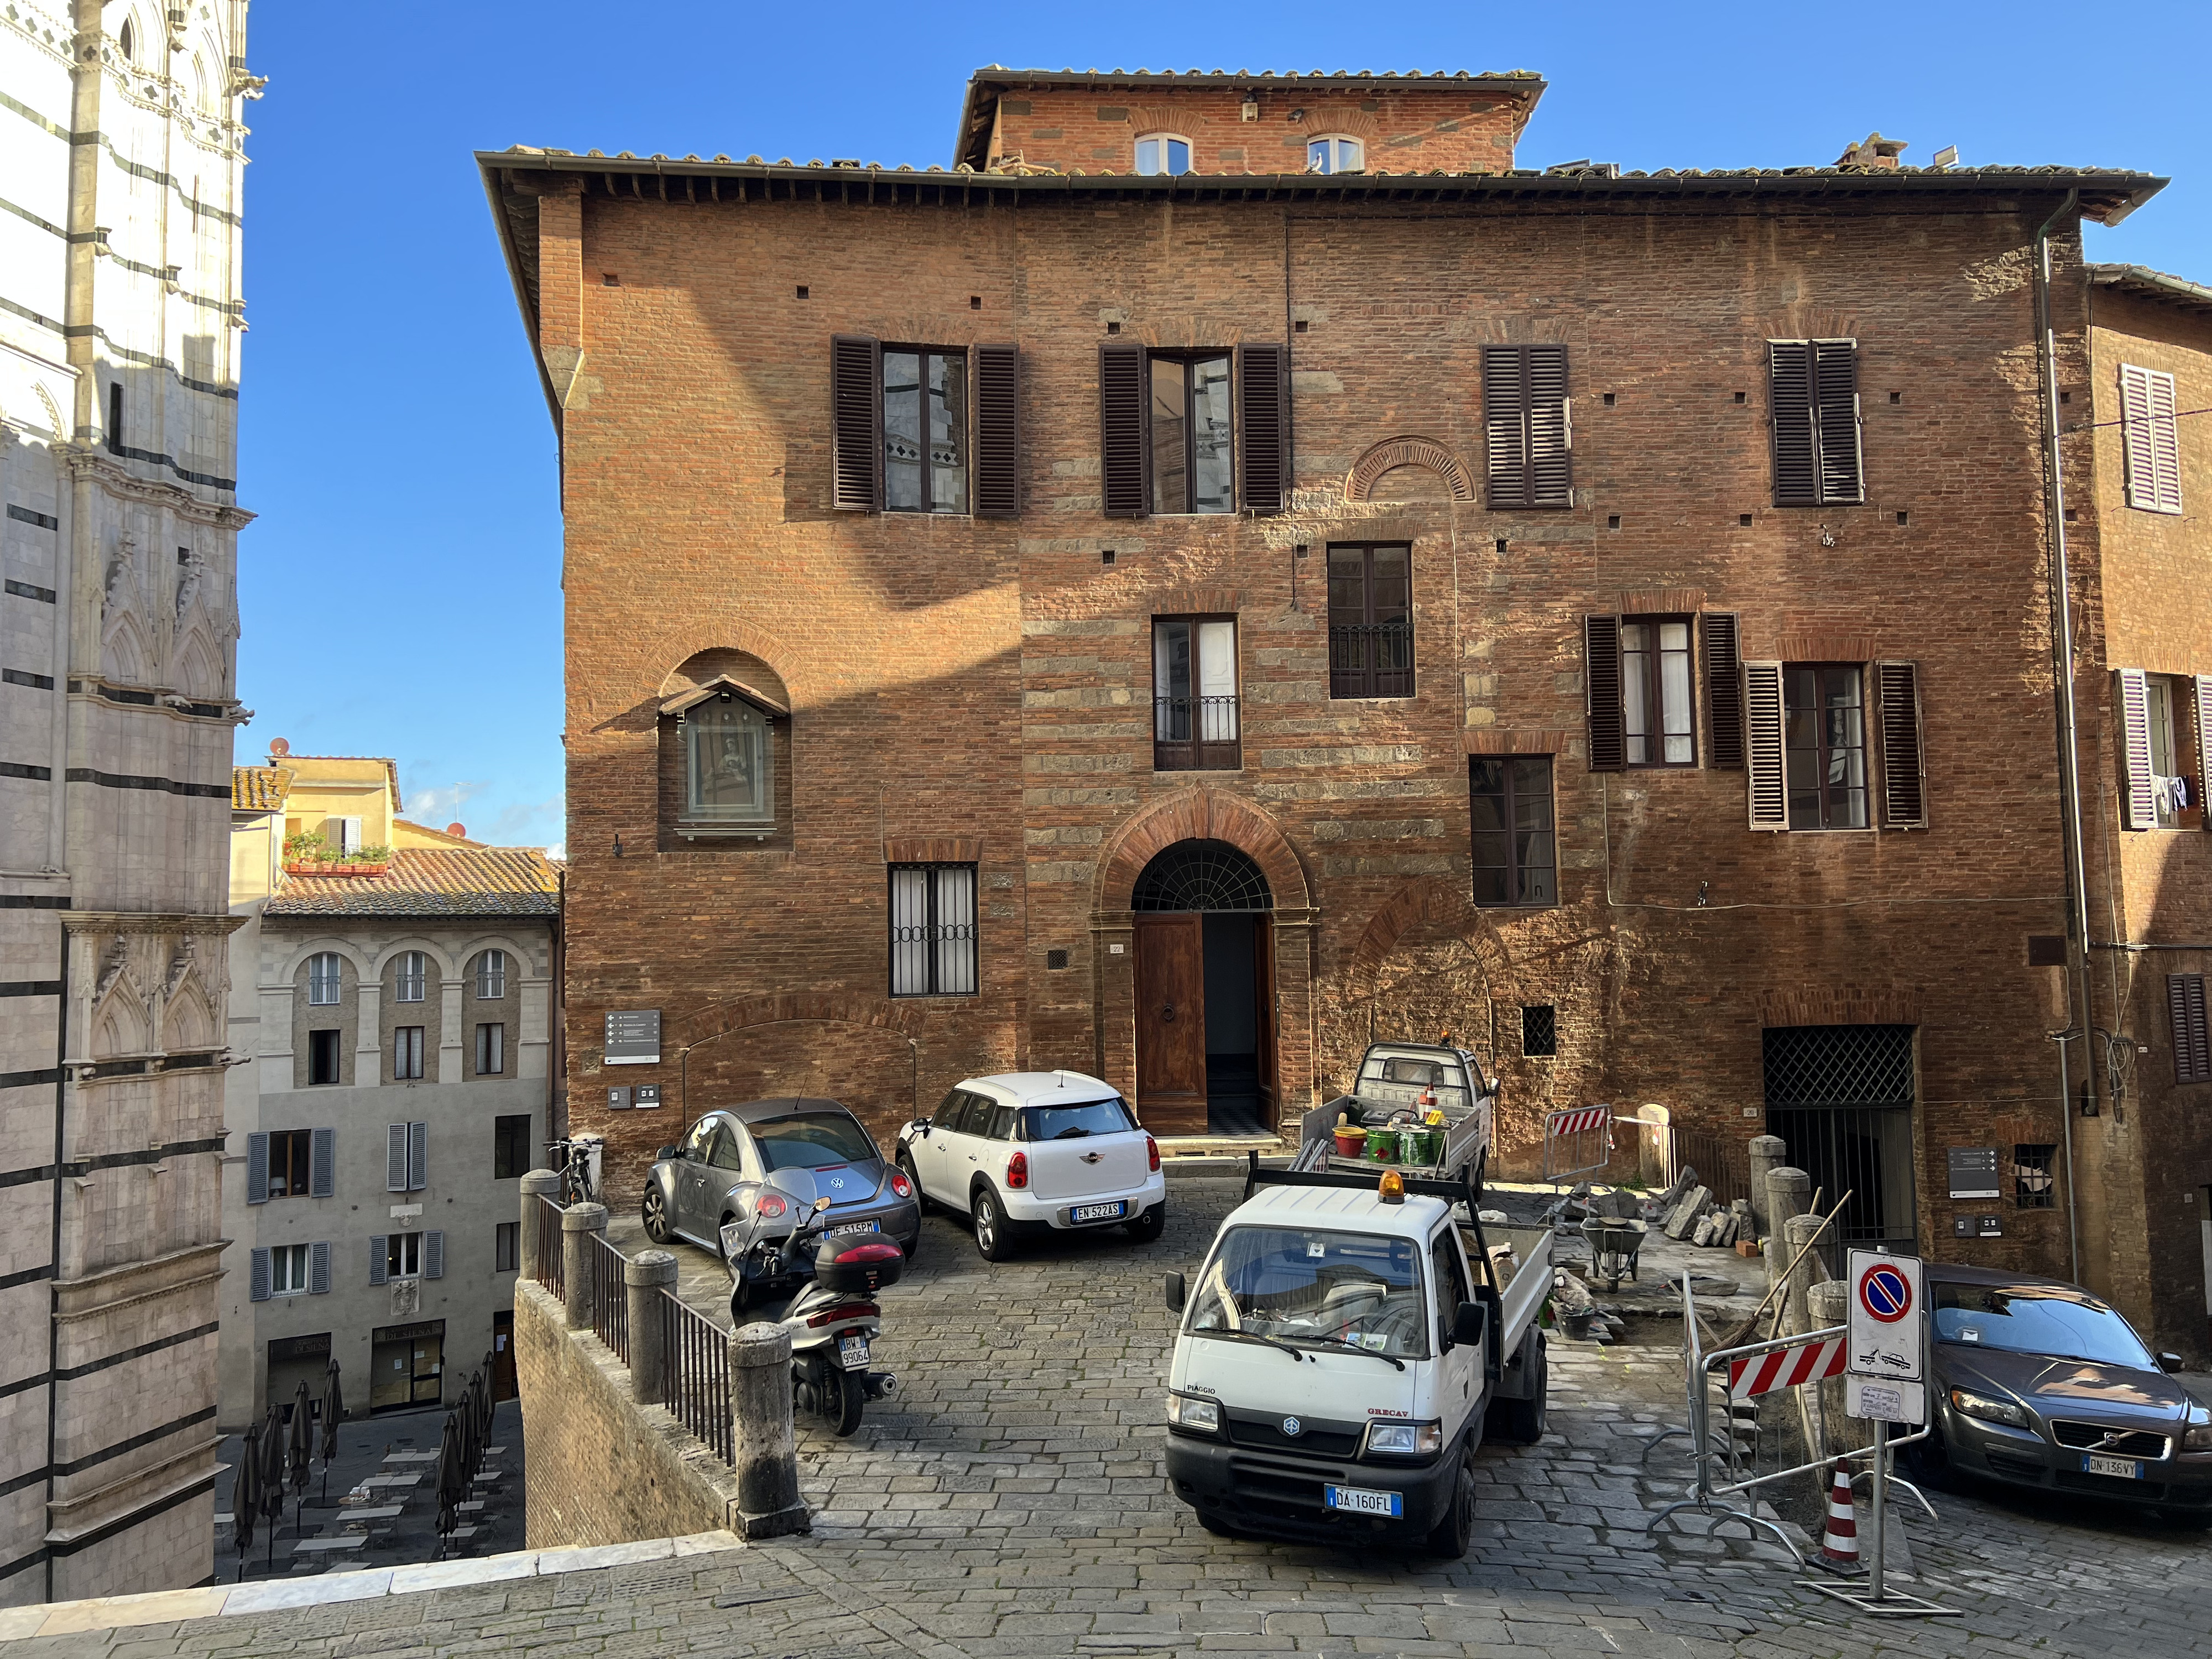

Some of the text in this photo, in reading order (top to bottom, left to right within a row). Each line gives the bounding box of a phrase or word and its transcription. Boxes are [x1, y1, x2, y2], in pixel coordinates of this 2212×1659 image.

[1078, 1204, 1118, 1219] EN 522AS
[845, 1222, 873, 1234] 515PM
[402, 1329, 431, 1338] SIENA
[846, 1338, 856, 1349] BW
[843, 1350, 868, 1364] 99064
[1187, 1385, 1215, 1394] PIAGGIO
[1367, 1408, 1408, 1417] GRECAV
[2090, 1459, 2136, 1475] DN 136VY
[1337, 1492, 1391, 1511] DA 160FL
